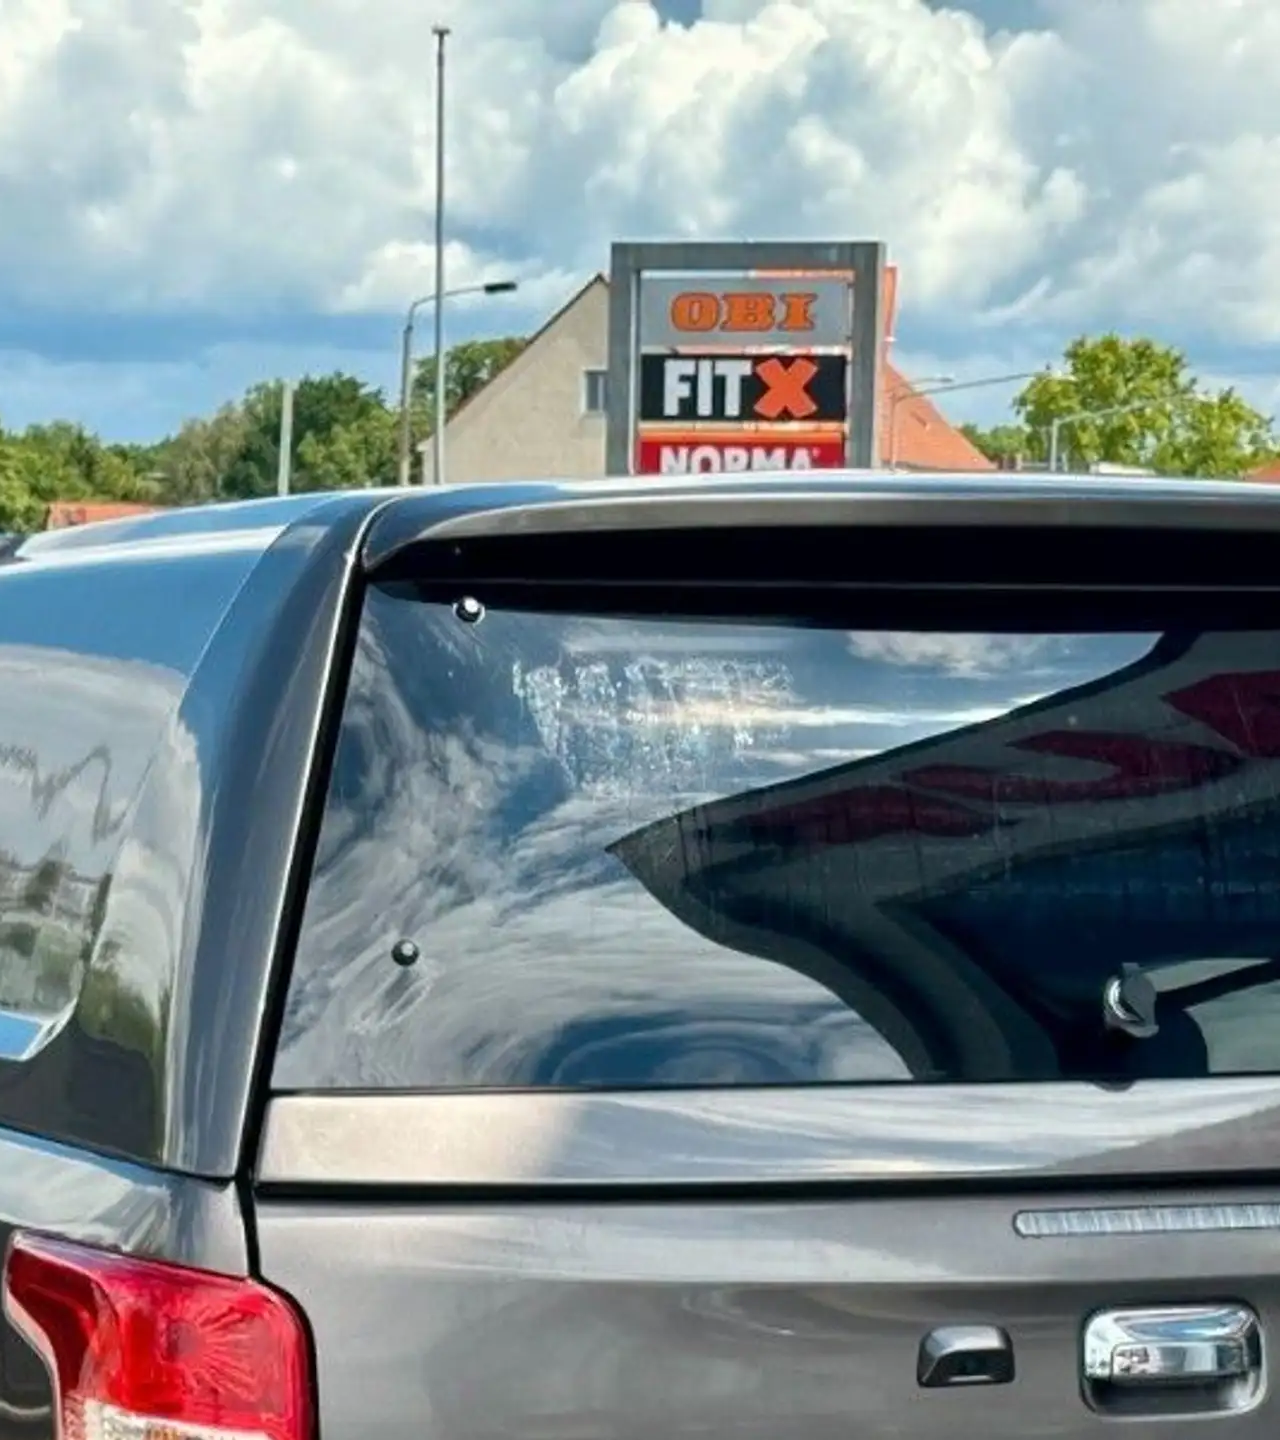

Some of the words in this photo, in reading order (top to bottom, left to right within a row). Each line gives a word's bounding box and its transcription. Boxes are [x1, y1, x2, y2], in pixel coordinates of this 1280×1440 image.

[670, 291, 818, 332] OBI
[663, 357, 818, 418] FITX
[660, 445, 813, 473] NORMA
